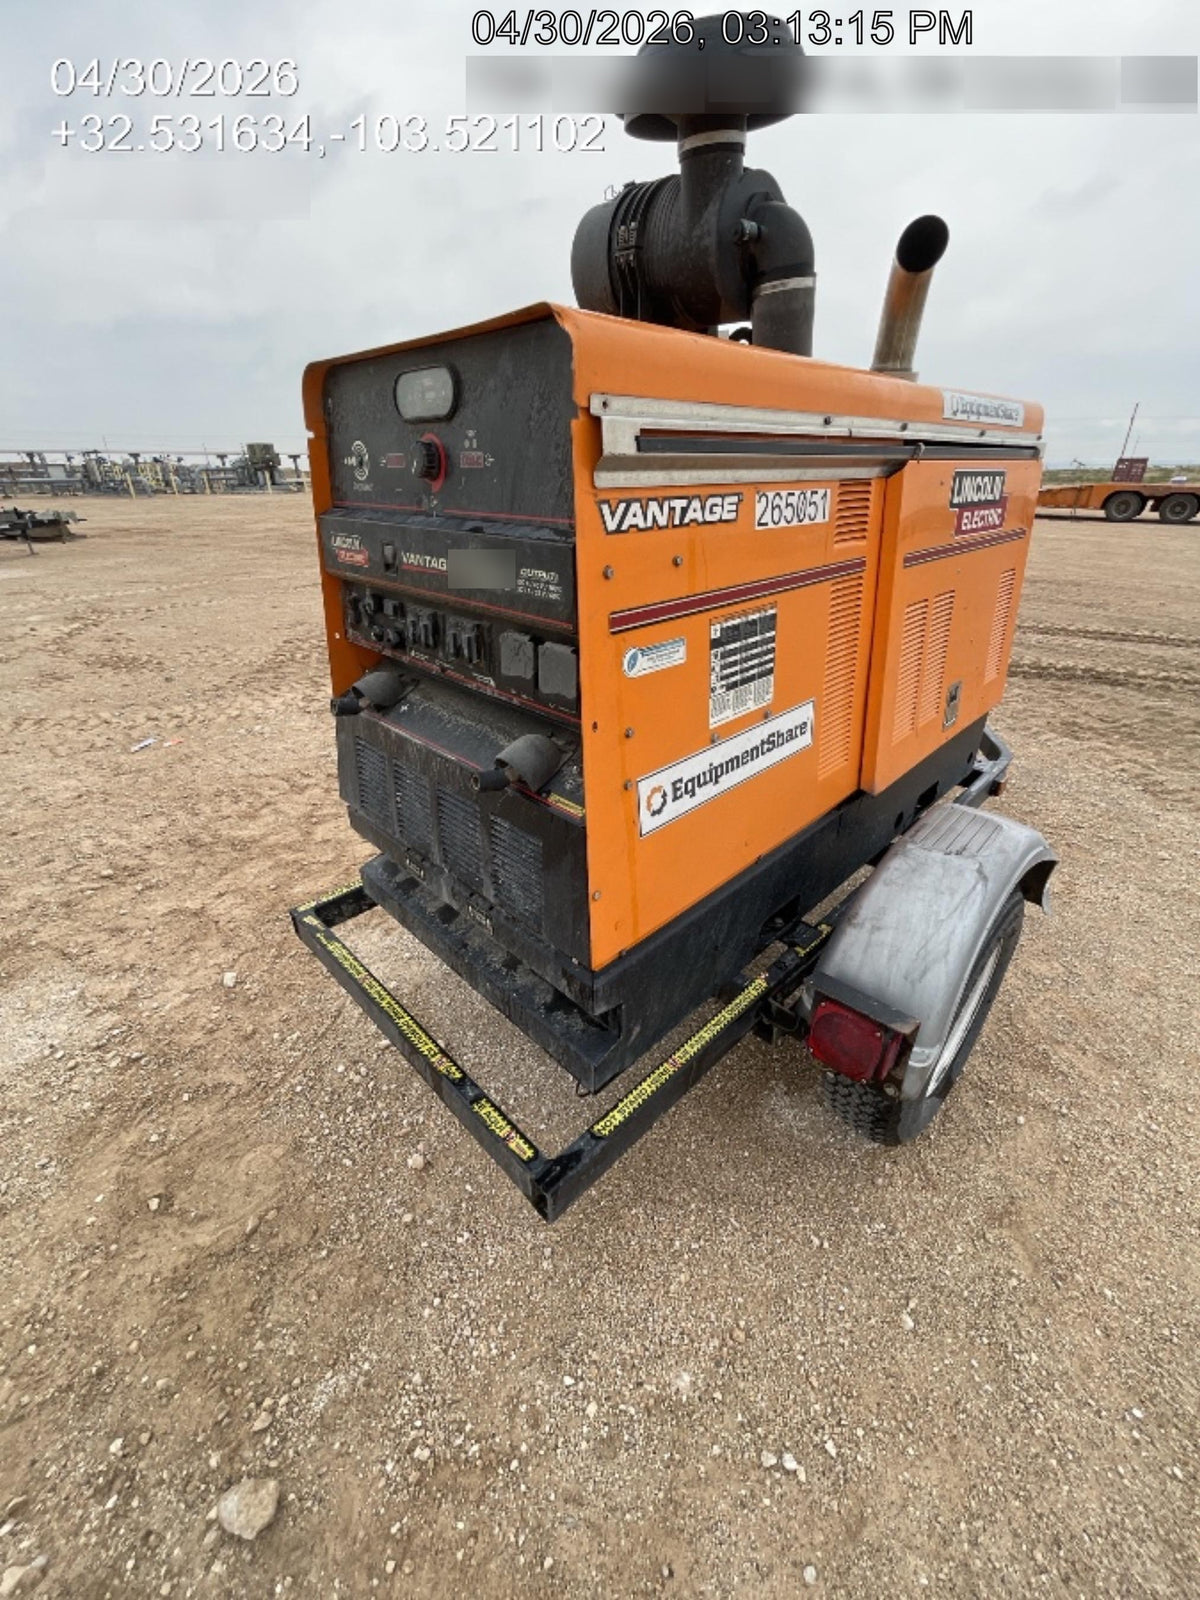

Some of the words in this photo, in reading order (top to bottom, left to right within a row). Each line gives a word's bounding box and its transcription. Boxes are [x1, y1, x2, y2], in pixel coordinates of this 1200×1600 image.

[952, 475, 1004, 504] LINCOLN
[600, 495, 739, 533] VANTAGE
[756, 490, 828, 526] 265051
[961, 508, 1002, 530] ELECTRIC
[401, 551, 448, 571] VANTAG
[671, 720, 808, 802] EquipmentShare
